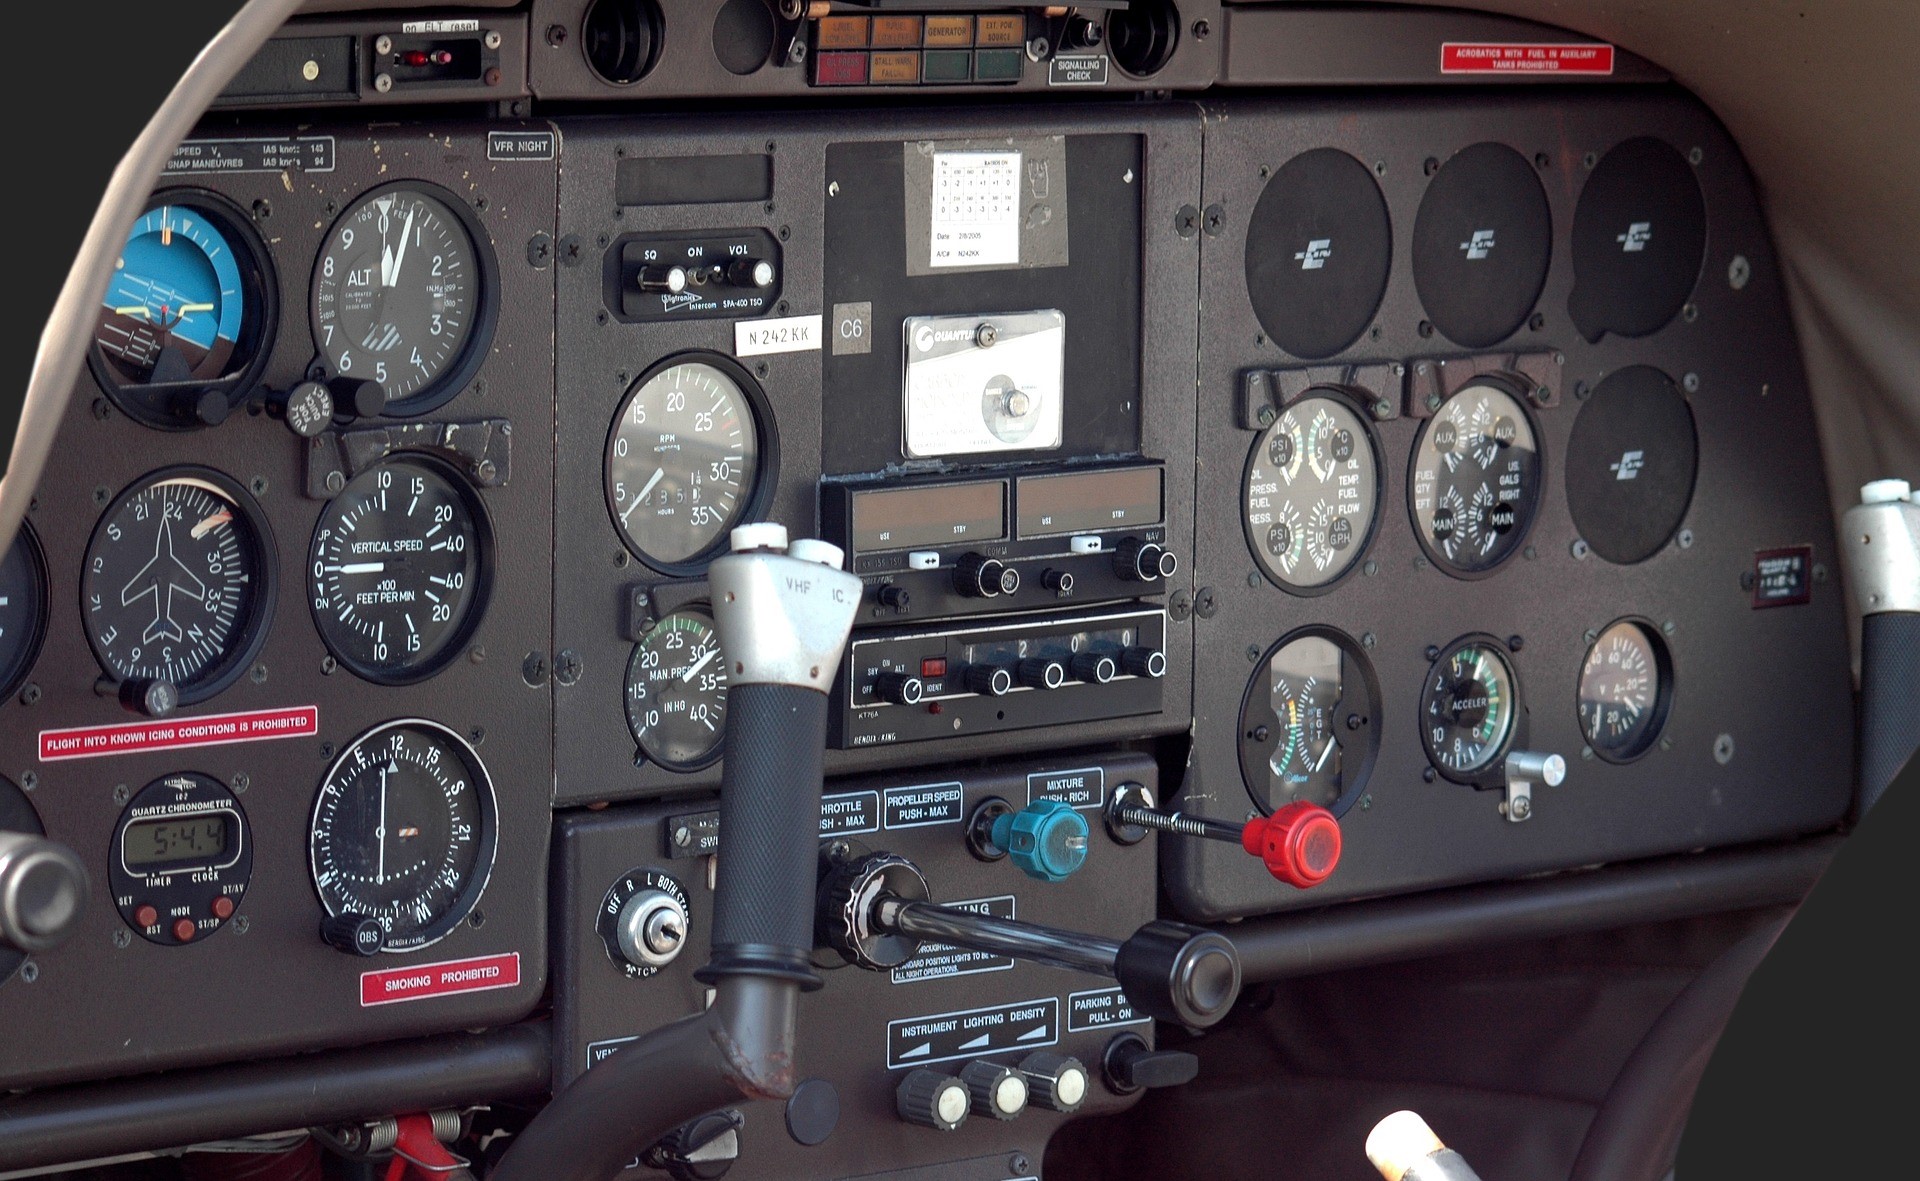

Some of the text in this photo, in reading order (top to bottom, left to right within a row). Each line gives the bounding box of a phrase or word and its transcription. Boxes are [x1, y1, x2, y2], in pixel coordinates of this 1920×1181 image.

[404, 21, 477, 34] on ELT reset
[927, 27, 967, 36] GENERATOR
[987, 33, 1011, 42] SOURCE
[1456, 48, 1597, 59] ACROBATICS WITH FUEL IN AUXILIARY
[1058, 60, 1100, 70] SIGNALLING
[1492, 60, 1559, 70] TANKS PROHIBITED
[1066, 70, 1091, 80] CHECK
[263, 145, 277, 154] IAS
[310, 144, 324, 153] 143
[494, 141, 548, 152] VFR NIGHT
[191, 158, 244, 168] MANEUVRES
[263, 157, 277, 167] IAS
[314, 157, 324, 166] 94
[644, 249, 657, 260] SQ
[687, 246, 703, 257] ON
[729, 245, 748, 256] VOL
[347, 268, 372, 287] ALT
[322, 294, 335, 303] 1015
[689, 298, 763, 310] Intercom SPA-400 TSO
[841, 319, 863, 339] C6
[762, 328, 788, 345] 242
[792, 326, 809, 341] KK
[305, 393, 321, 422] QUICK
[313, 386, 331, 417] ERECT
[666, 392, 685, 412] 20
[291, 404, 308, 433] PULL
[299, 404, 312, 423] FOR
[633, 404, 646, 425] 15
[694, 412, 713, 432] 25
[659, 434, 676, 443] RPM
[1435, 432, 1455, 443] AUX.
[1495, 427, 1515, 439] AUX.
[614, 438, 628, 458] 10
[1271, 441, 1288, 451] PSI
[1336, 446, 1348, 456] x10
[1273, 453, 1286, 463] x10
[1347, 459, 1359, 470] OIL
[709, 462, 729, 482] 30
[1415, 470, 1435, 480] FUEL
[378, 471, 392, 489] 10
[411, 477, 425, 495] 15
[1338, 474, 1359, 486] TEMP.
[1499, 475, 1520, 486] GALS
[1338, 488, 1358, 499] FUEL
[1415, 484, 1431, 494] QTY
[1499, 489, 1520, 501] RIGHT
[1250, 498, 1271, 508] FUEL
[1338, 503, 1360, 515] FLOW
[434, 505, 453, 522] 20
[657, 508, 675, 516] HOURS
[690, 506, 709, 526] 35
[1111, 510, 1125, 519] STBY
[1041, 516, 1052, 525] USE
[1432, 519, 1454, 531] MAIN
[1491, 512, 1514, 526] MAIN
[953, 525, 967, 534] STBY
[1270, 529, 1288, 541] PSI
[879, 532, 890, 541] USE
[1145, 531, 1160, 541] NAV
[351, 539, 423, 554] VERTICAL SPEED
[446, 535, 465, 552] 40
[1272, 542, 1286, 554] x10
[987, 546, 1008, 556] COMM
[376, 580, 396, 591] x100
[445, 572, 464, 590] 40
[785, 577, 812, 595] VHF
[356, 592, 379, 605] FEET
[380, 591, 398, 604] PER
[832, 588, 844, 604] IC
[432, 604, 451, 622] 20
[407, 634, 421, 652] 15
[666, 632, 684, 650] 25
[374, 643, 388, 661] 10
[641, 650, 659, 669] 20
[867, 667, 879, 677] SBY
[894, 664, 906, 673] ALT
[699, 673, 717, 692] 35
[926, 684, 943, 693] IDENT
[633, 682, 646, 699] 15
[862, 685, 873, 695] OFF
[664, 700, 686, 714] IN HG
[1452, 697, 1487, 711] ACCELER
[645, 709, 659, 727] 10
[689, 704, 708, 722] 40
[46, 716, 308, 752] FLIGHT INTO KNOWN ICING CONDITIONS IS PROHIBITED
[390, 735, 404, 751] 12
[1046, 778, 1084, 791] MIXTURE
[887, 790, 960, 808] PROPELLER SPEED
[1069, 791, 1090, 803] RICH
[131, 799, 233, 817] QUARTZ CHRONOMETER
[821, 801, 862, 815] HROTTLE
[899, 805, 949, 821] PUSH MAX
[845, 815, 866, 828] MAX
[146, 876, 172, 888] TIMER
[192, 871, 219, 883] CLOCK
[223, 884, 244, 895] DT/AV
[657, 874, 678, 897] BOTH
[119, 896, 133, 906] SET
[607, 893, 621, 915] OFF
[170, 906, 191, 917] MODE
[146, 924, 162, 935] RST
[198, 918, 220, 930] ST/SP
[359, 931, 378, 943] OBS
[925, 956, 951, 969] POSITION
[951, 953, 971, 965] LIGHTS
[972, 952, 981, 961] TO
[385, 966, 500, 992] SMOKING PROHIBITED
[894, 970, 905, 980] ALL
[905, 969, 923, 979] NIGHT
[1075, 996, 1112, 1011] PARKING
[1089, 1008, 1132, 1023] PULL ON
[901, 1007, 1046, 1038] INSTRUMENT LIGHTING DENSITY
